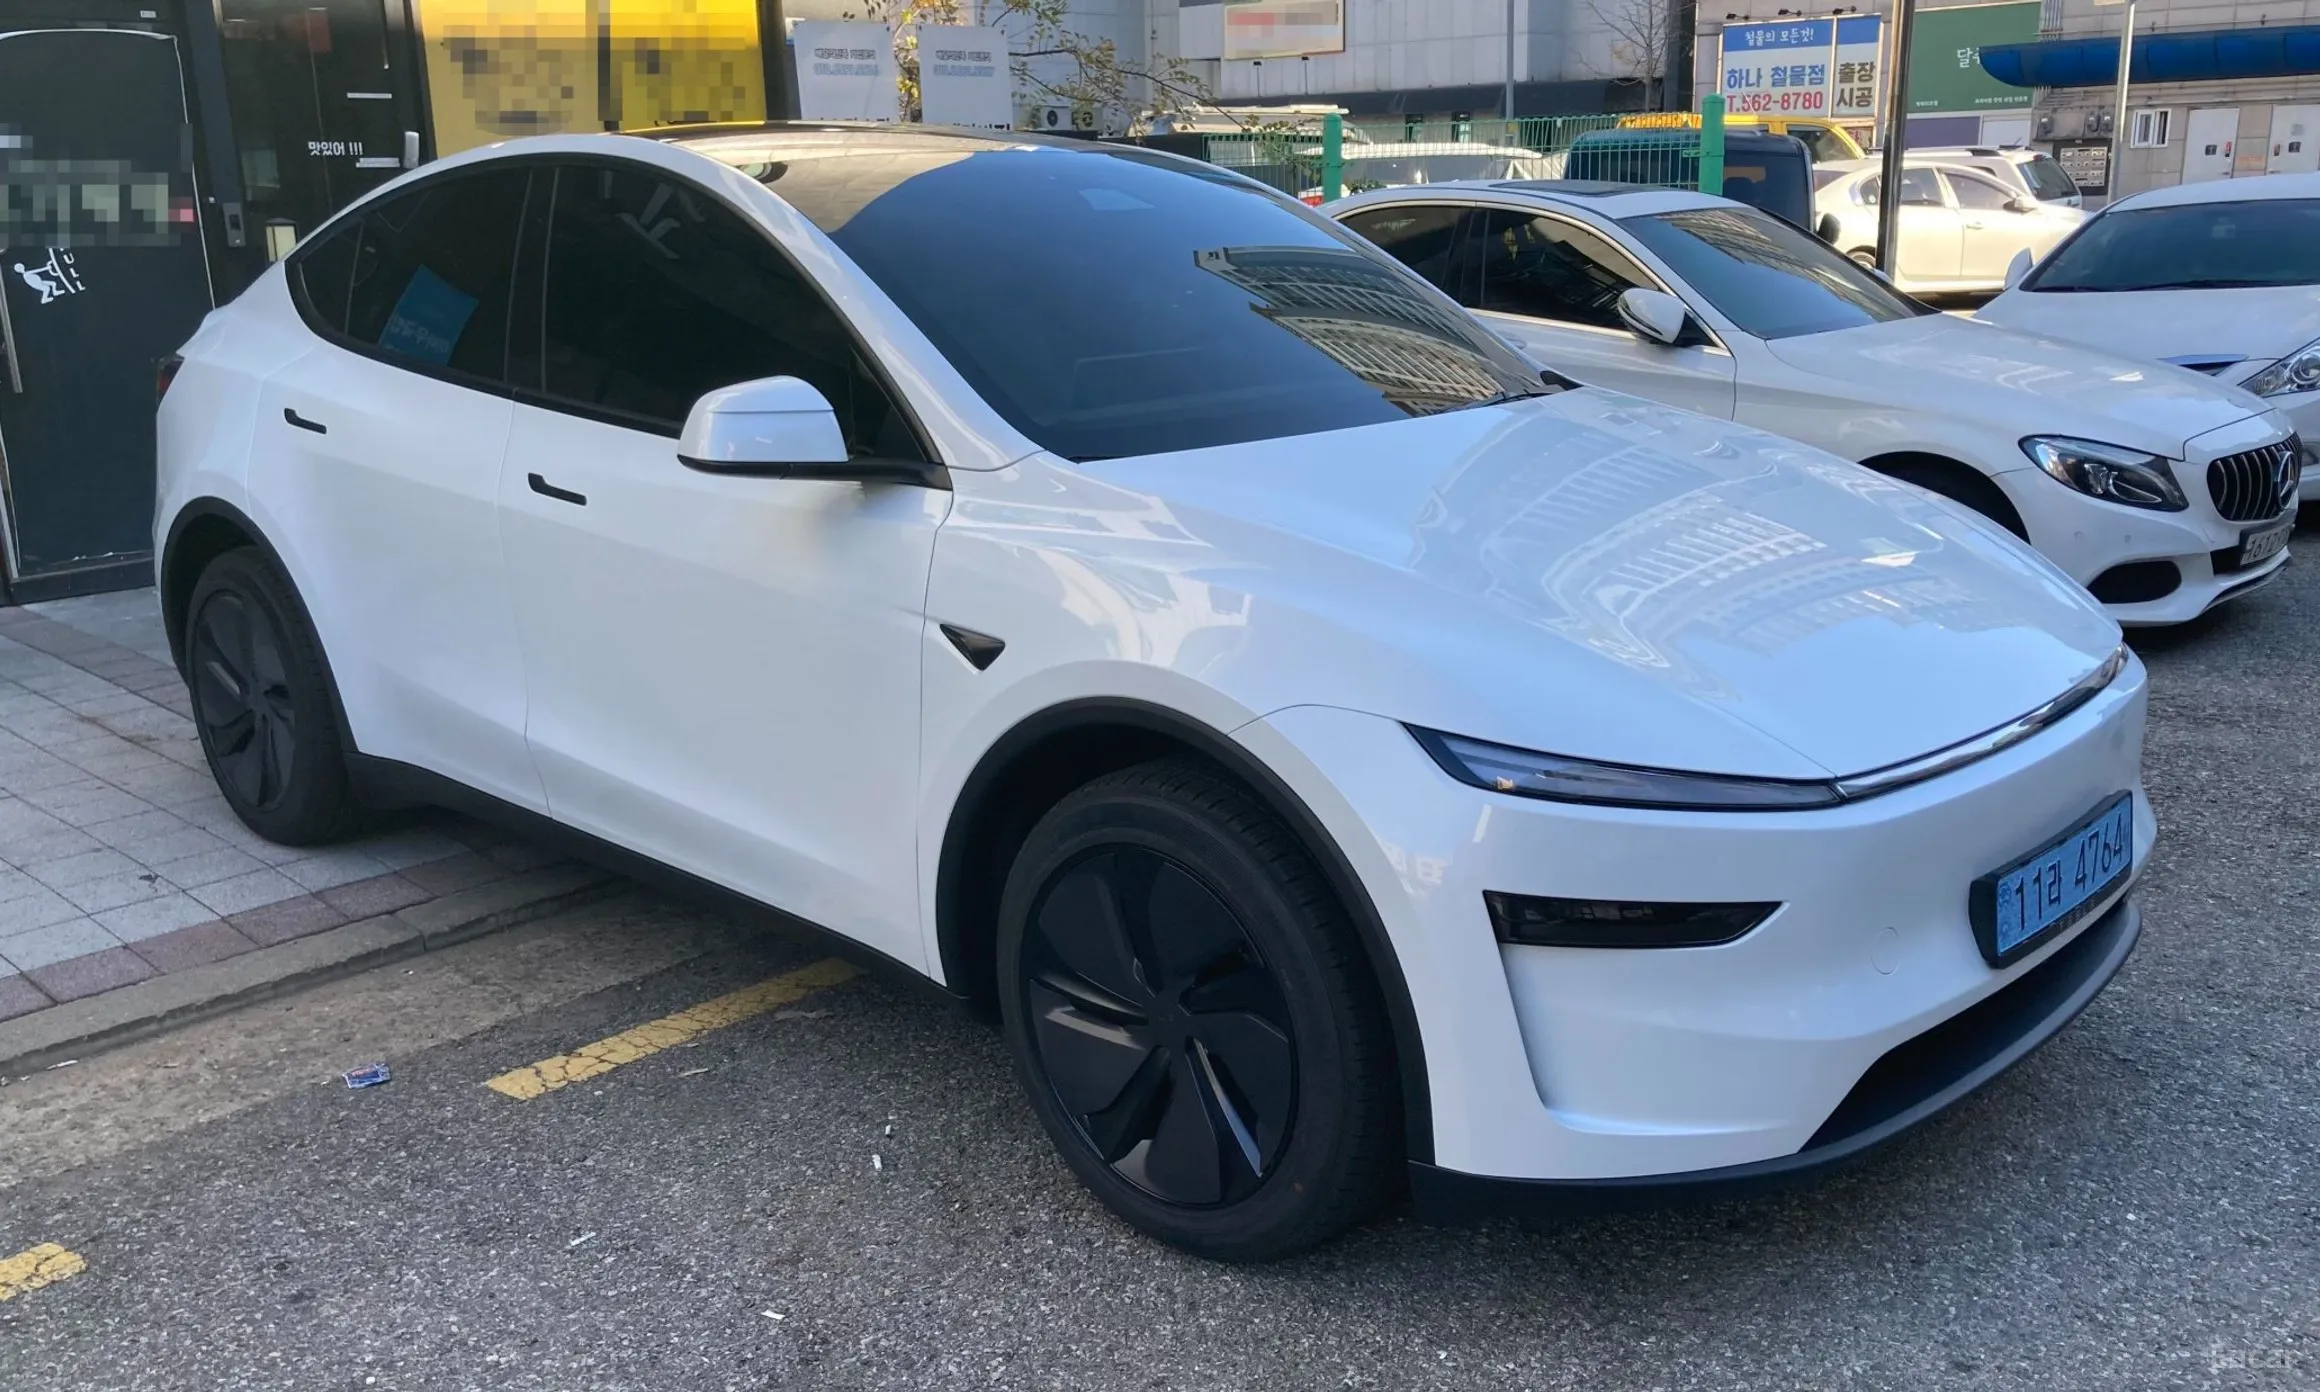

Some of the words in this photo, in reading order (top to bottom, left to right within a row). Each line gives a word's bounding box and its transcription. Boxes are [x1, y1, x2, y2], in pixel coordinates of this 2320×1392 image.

[1744, 29, 1775, 47] 철물의
[1780, 27, 1814, 44] 모든것!
[1726, 67, 1763, 89] 하나
[1770, 64, 1825, 88] 철물점
[1838, 61, 1876, 84] 출장
[1726, 91, 1824, 113] T.562-8780
[1836, 87, 1873, 109] 시공
[307, 141, 345, 156] 맛있어
[349, 141, 363, 156] !!!
[60, 248, 86, 291] ULL
[2015, 859, 2063, 932] 11라
[2074, 812, 2123, 891] 4764
